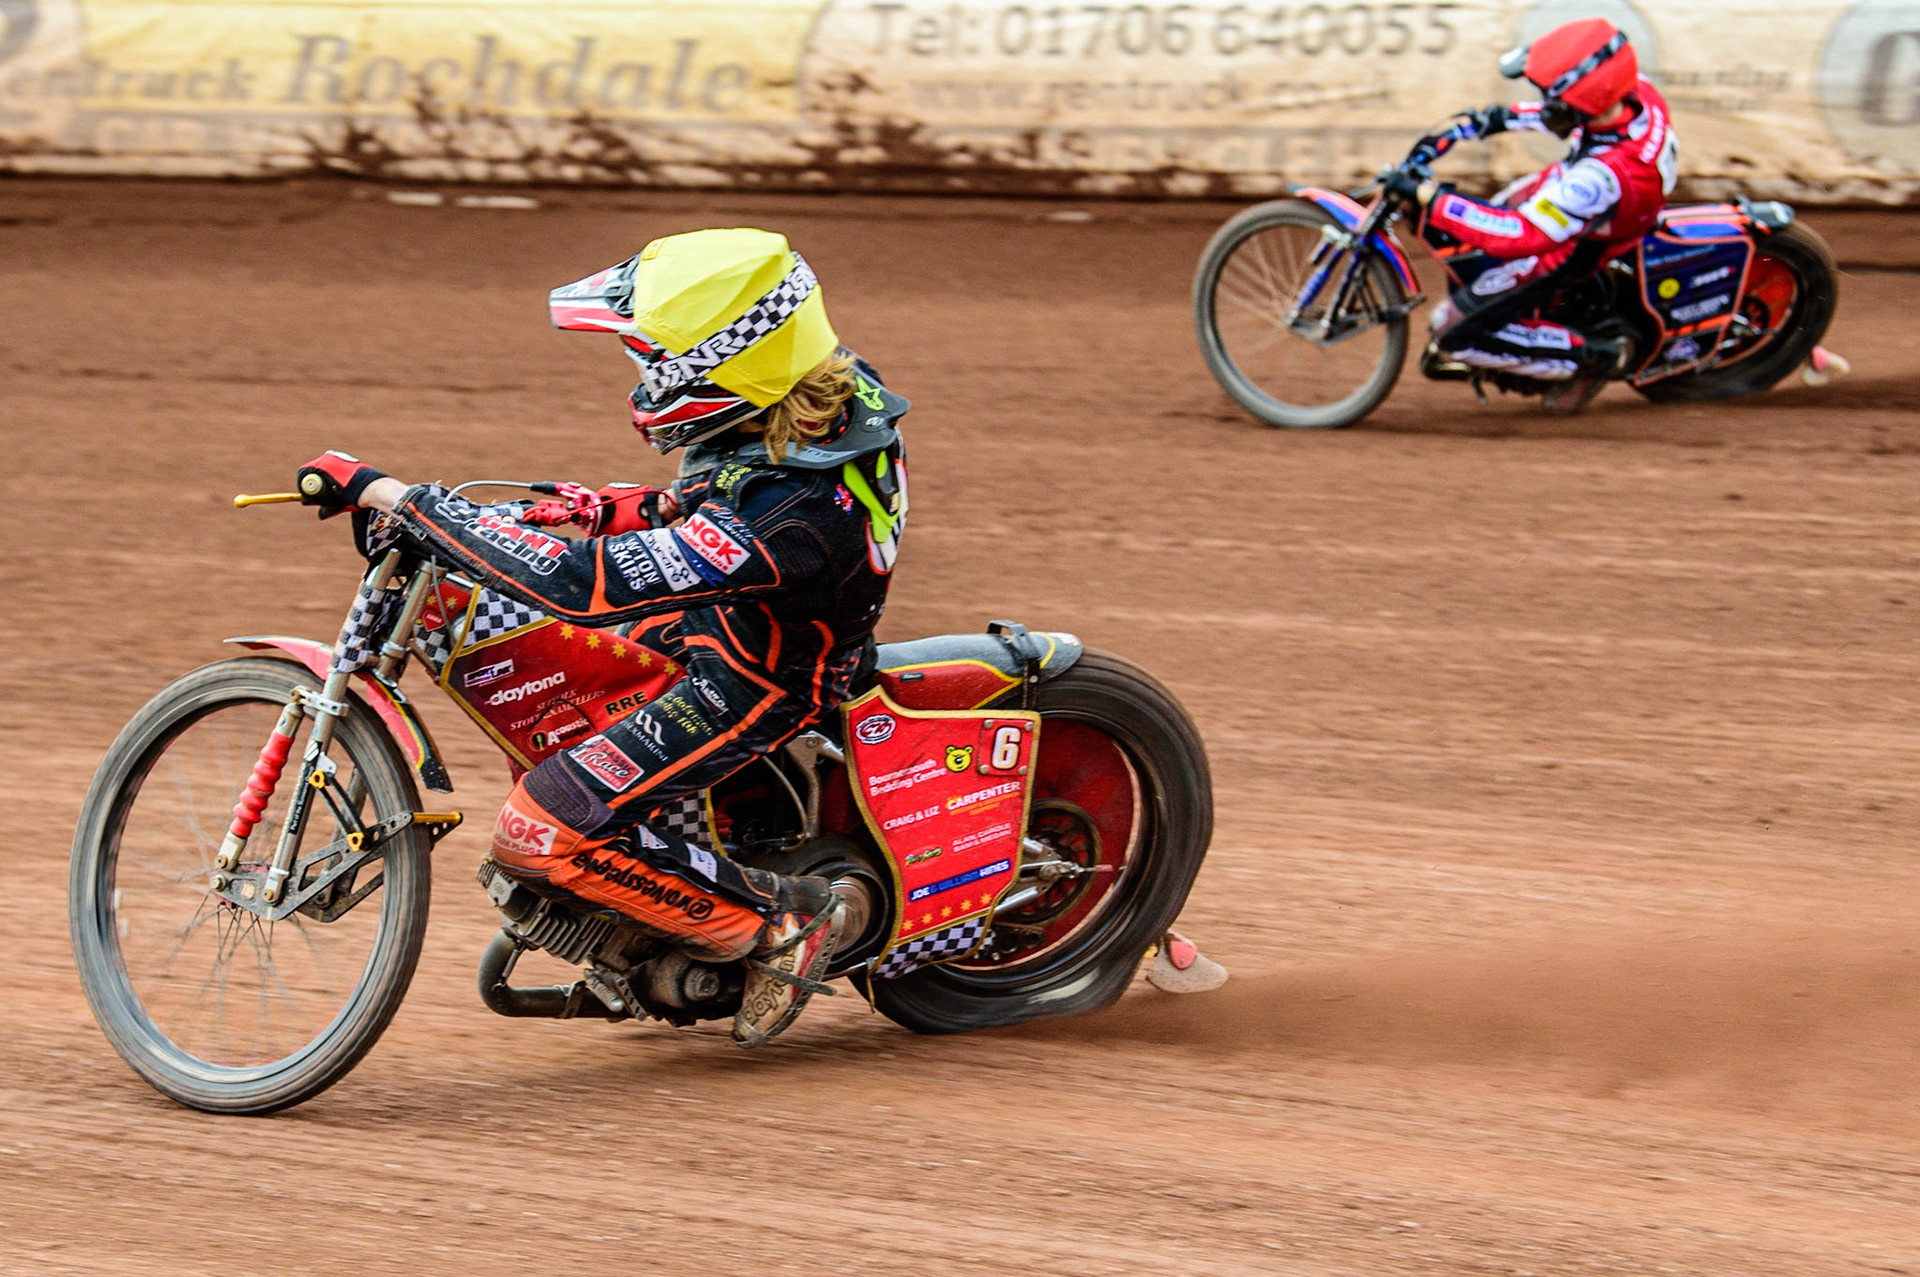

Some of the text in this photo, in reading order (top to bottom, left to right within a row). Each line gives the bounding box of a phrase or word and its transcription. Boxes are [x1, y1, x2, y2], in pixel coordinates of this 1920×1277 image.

[996, 2, 1193, 56] 01706
[1213, 2, 1455, 56] 640055
[274, 32, 752, 111] Rochdale
[464, 521, 562, 576] racing
[683, 517, 742, 566] NGK
[608, 542, 646, 591] SKIPS
[486, 671, 567, 706] daytona
[604, 691, 649, 716] RRE
[547, 717, 590, 746] Acoustic
[991, 726, 1021, 770] 6
[582, 750, 631, 781] Race
[913, 766, 948, 786] Centre
[946, 780, 1021, 811] CARPENTER
[498, 807, 551, 848] NGK
[883, 811, 915, 831] CRAIG
[925, 804, 941, 819] LIZ
[910, 886, 931, 901] JOE
